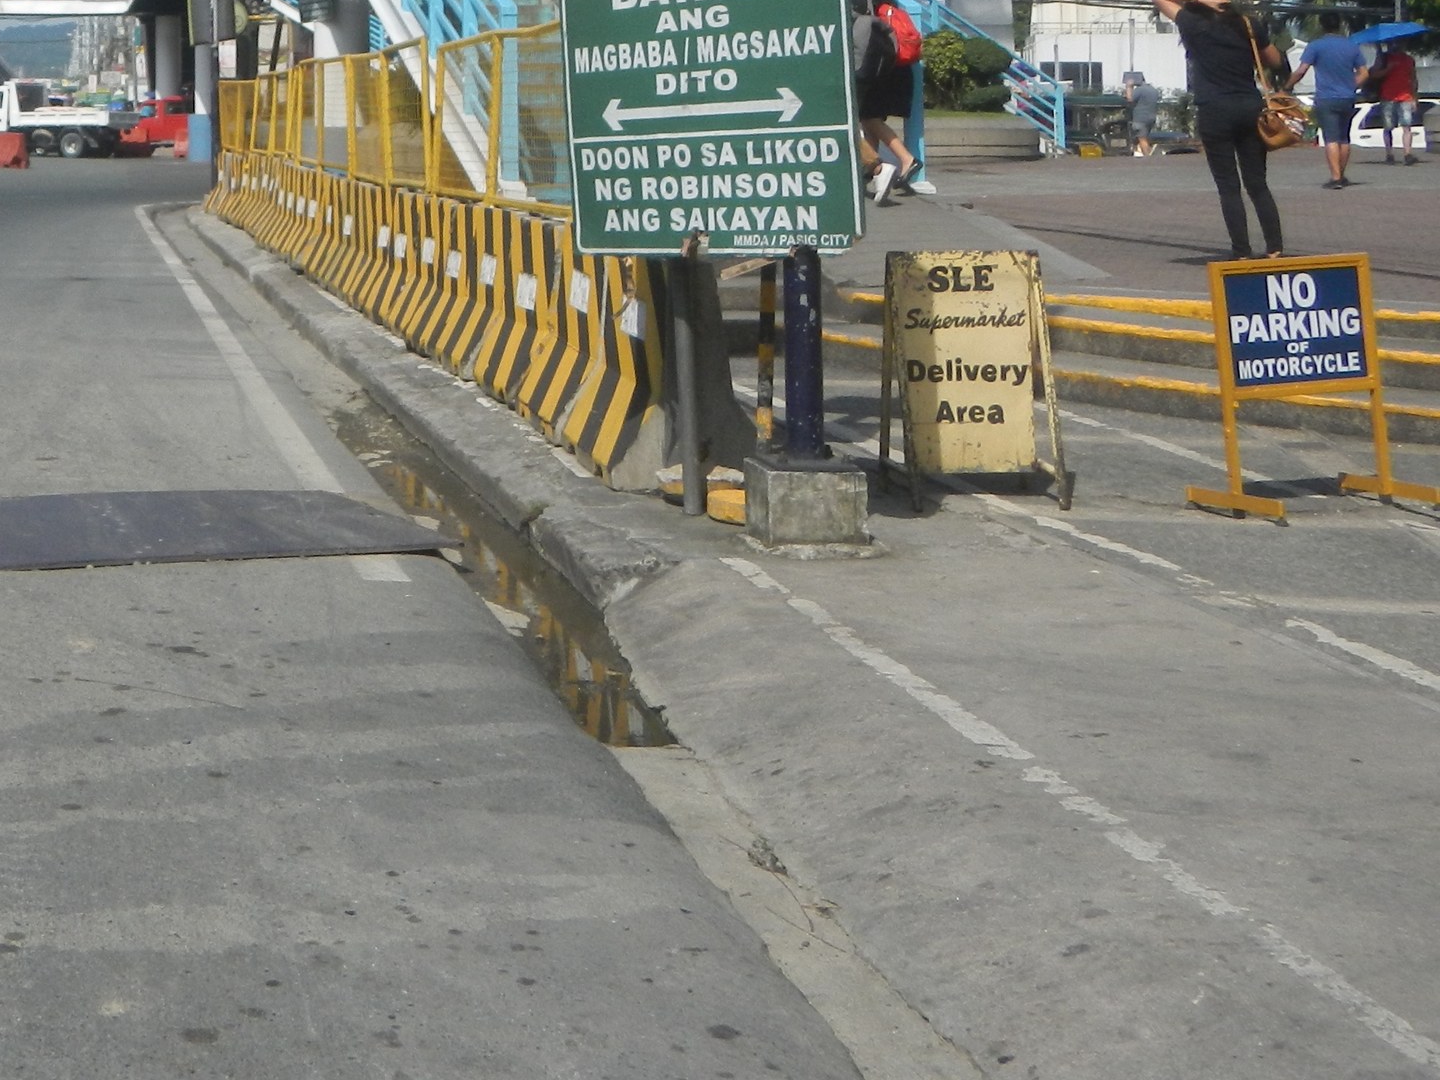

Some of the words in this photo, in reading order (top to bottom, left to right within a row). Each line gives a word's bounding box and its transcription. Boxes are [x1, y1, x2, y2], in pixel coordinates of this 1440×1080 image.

[656, 5, 730, 33] ANG
[575, 37, 678, 73] MAGBABA
[696, 24, 836, 64] MAGSAKAY
[656, 69, 738, 96] DITO
[581, 145, 649, 171] DOON
[657, 143, 691, 168] PO
[700, 141, 737, 166] SA
[746, 137, 840, 165] LIKOD
[594, 177, 632, 201] NG
[641, 171, 827, 200] ROBINSONS
[604, 208, 659, 232] ANG
[670, 205, 818, 232] SAKAYAN
[733, 234, 769, 246] MMDA
[780, 234, 818, 246] PASIG
[820, 234, 850, 246] CITY
[927, 264, 995, 293] SLE
[1266, 272, 1317, 310] NO
[904, 307, 1027, 335] Supermarket
[1229, 307, 1361, 344] PARKING
[1286, 341, 1309, 354] OF
[906, 357, 1030, 386] Delivery
[1238, 352, 1362, 380] MOTORCYCLE
[936, 400, 1005, 424] Area
